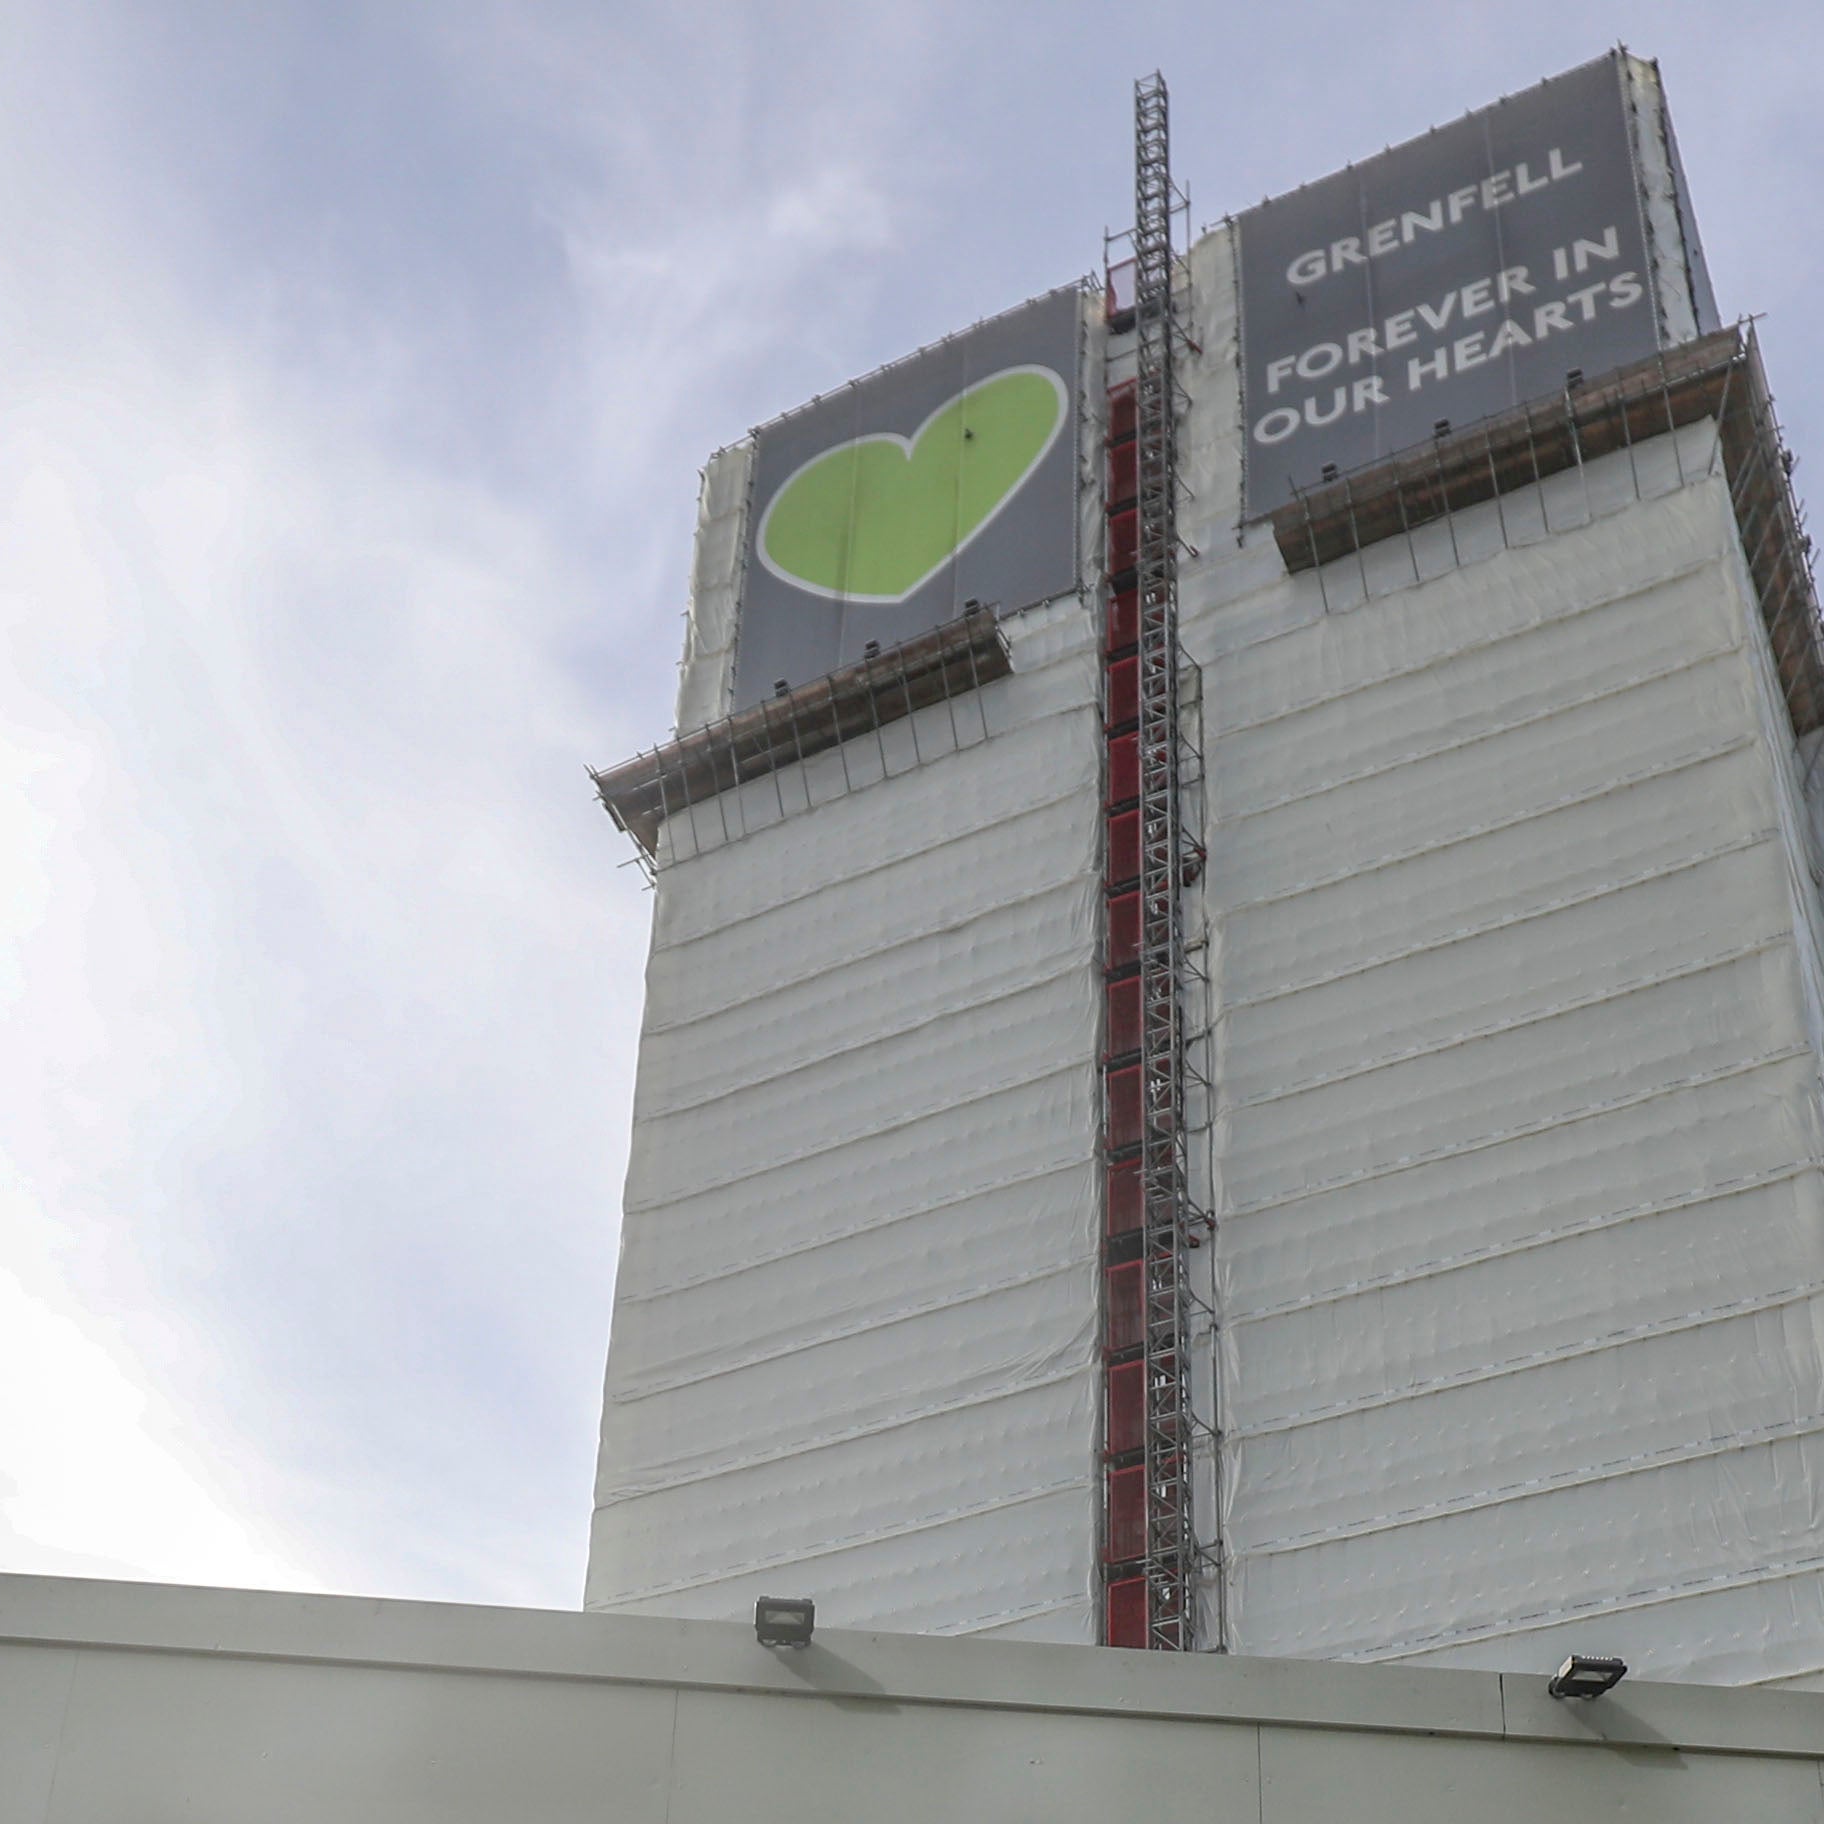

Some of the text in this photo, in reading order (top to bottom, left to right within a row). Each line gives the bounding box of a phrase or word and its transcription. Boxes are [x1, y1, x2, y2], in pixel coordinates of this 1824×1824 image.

[1286, 148, 1583, 285] GRENFELL
[1253, 271, 1643, 444] OUR HEARTS
[1267, 226, 1619, 394] FOREVER IN
